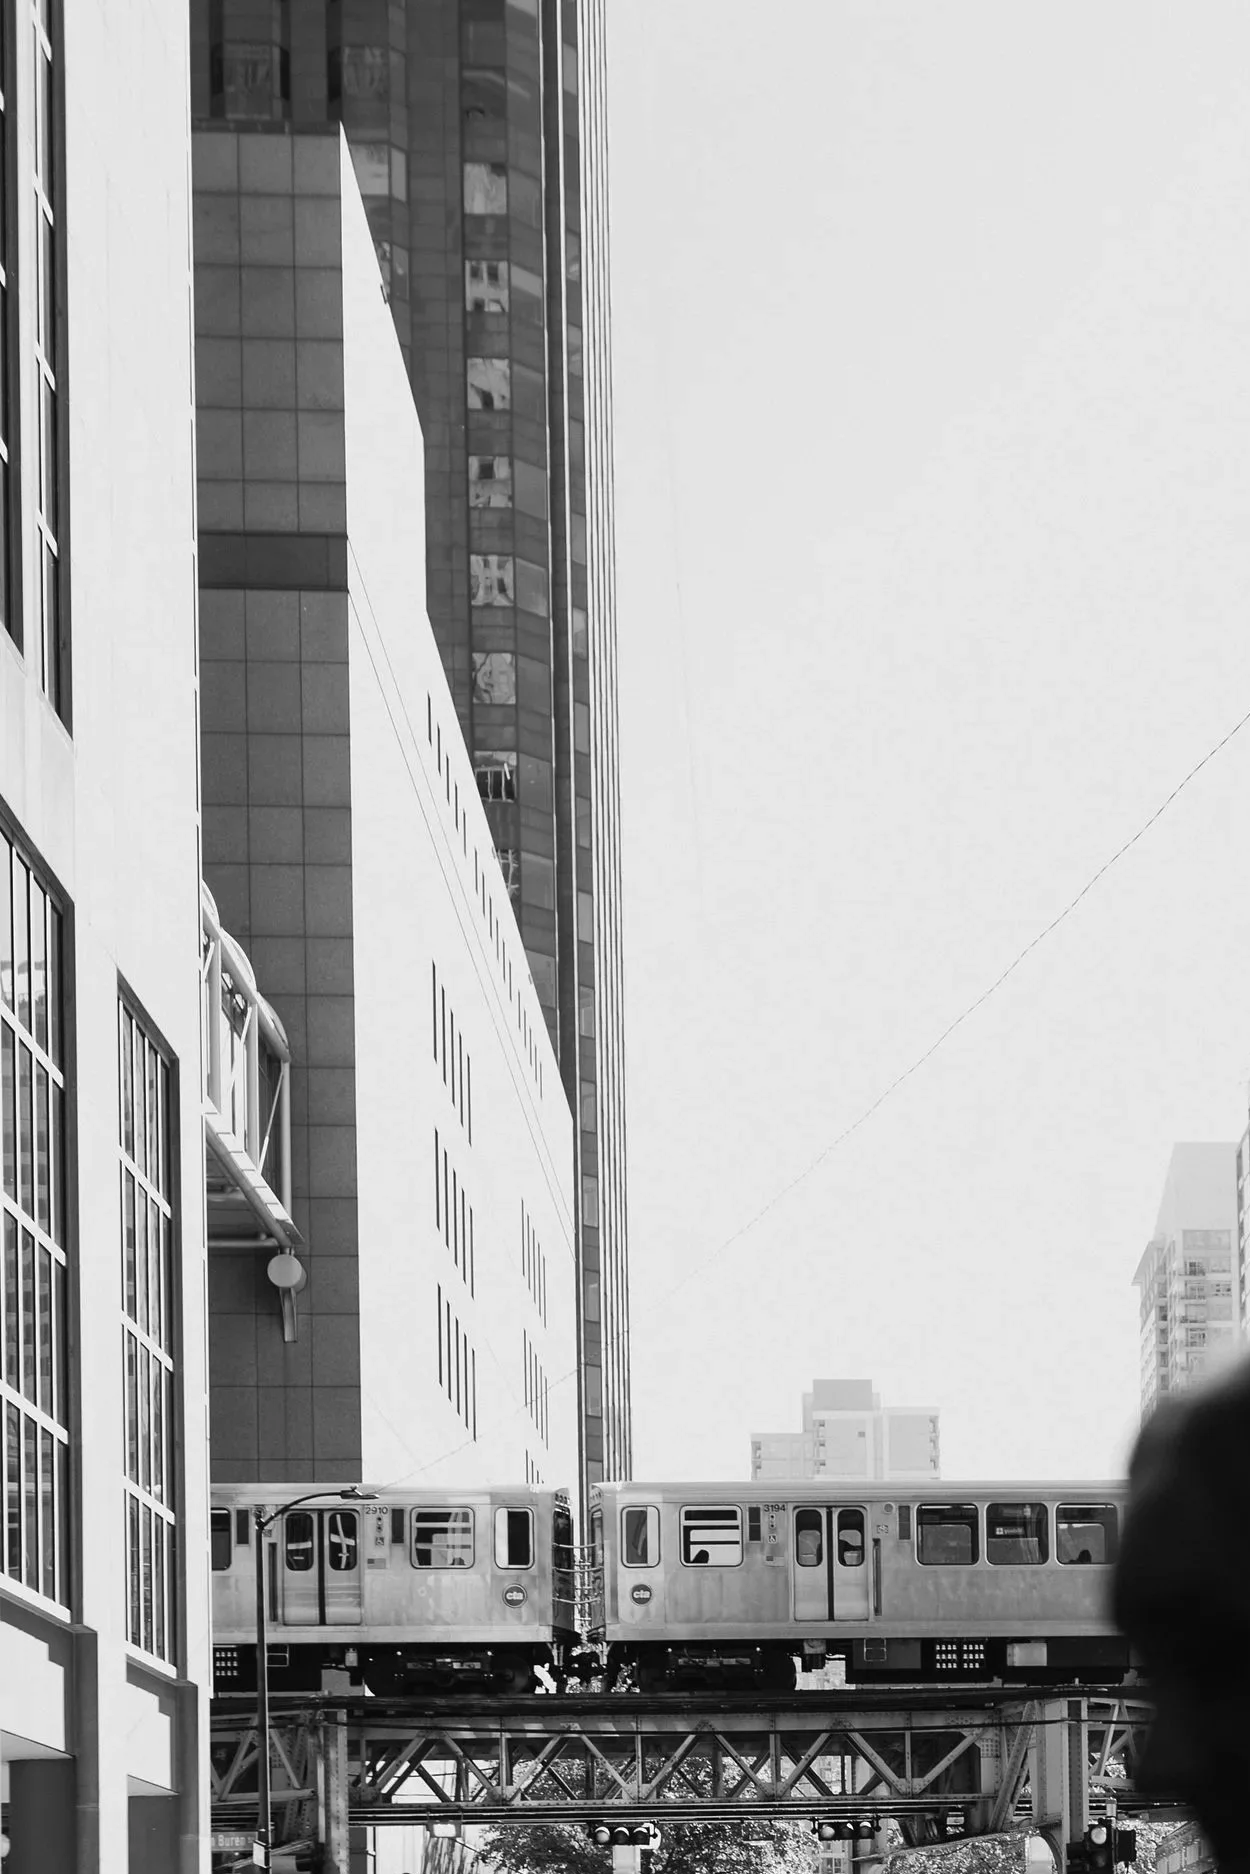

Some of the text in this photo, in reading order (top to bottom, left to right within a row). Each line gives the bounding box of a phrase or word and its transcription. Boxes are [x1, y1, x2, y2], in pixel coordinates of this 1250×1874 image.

[365, 1506, 388, 1515] 2910
[764, 1504, 786, 1512] 3194
[218, 1835, 246, 1847] Buren
